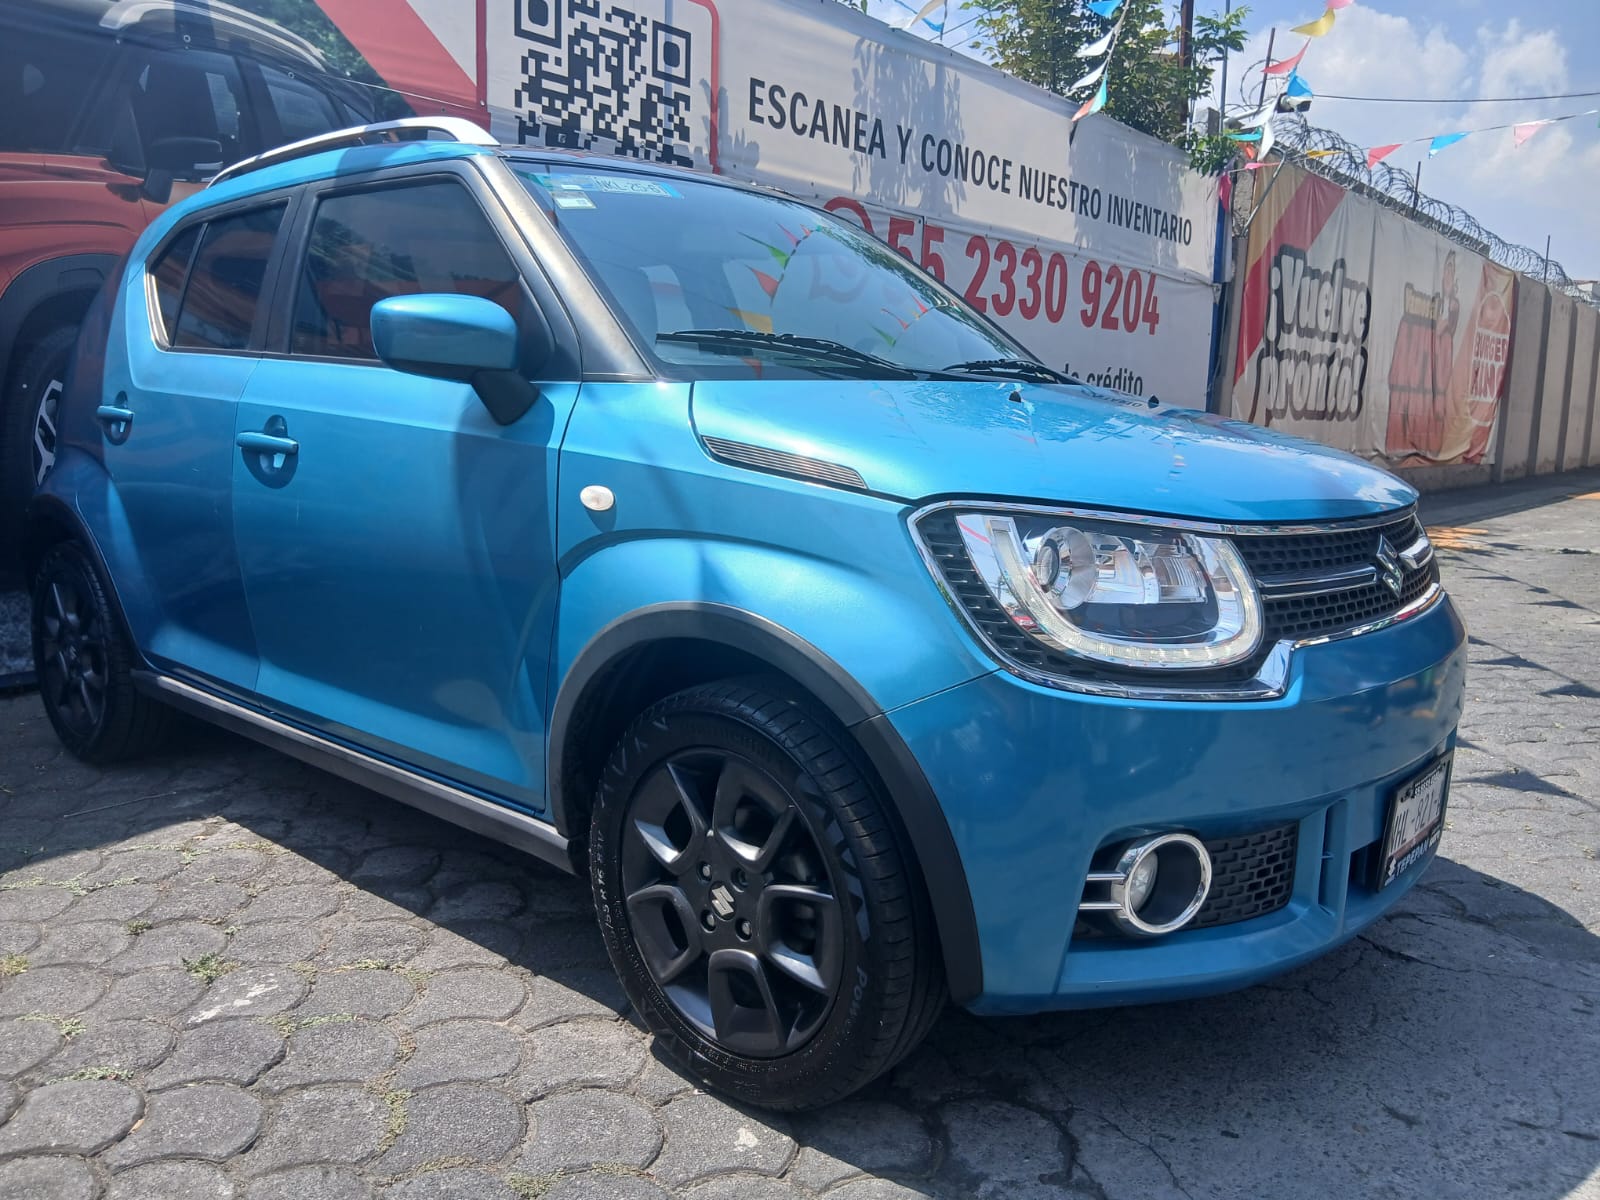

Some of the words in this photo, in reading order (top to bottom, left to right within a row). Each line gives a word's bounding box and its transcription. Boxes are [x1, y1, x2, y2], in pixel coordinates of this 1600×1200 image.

[749, 77, 887, 159] ESCANEA
[897, 124, 912, 165] Y
[921, 133, 1012, 194] CONOCE
[1019, 165, 1101, 220] NUESTRO
[1107, 193, 1192, 246] INVENTARIO
[888, 216, 945, 284] 55
[964, 235, 1068, 323] 2330
[1081, 260, 1160, 335] 9204
[1264, 245, 1371, 350] ¡Vuelve
[1086, 366, 1143, 396] crédito
[1250, 347, 1368, 423] pronto!
